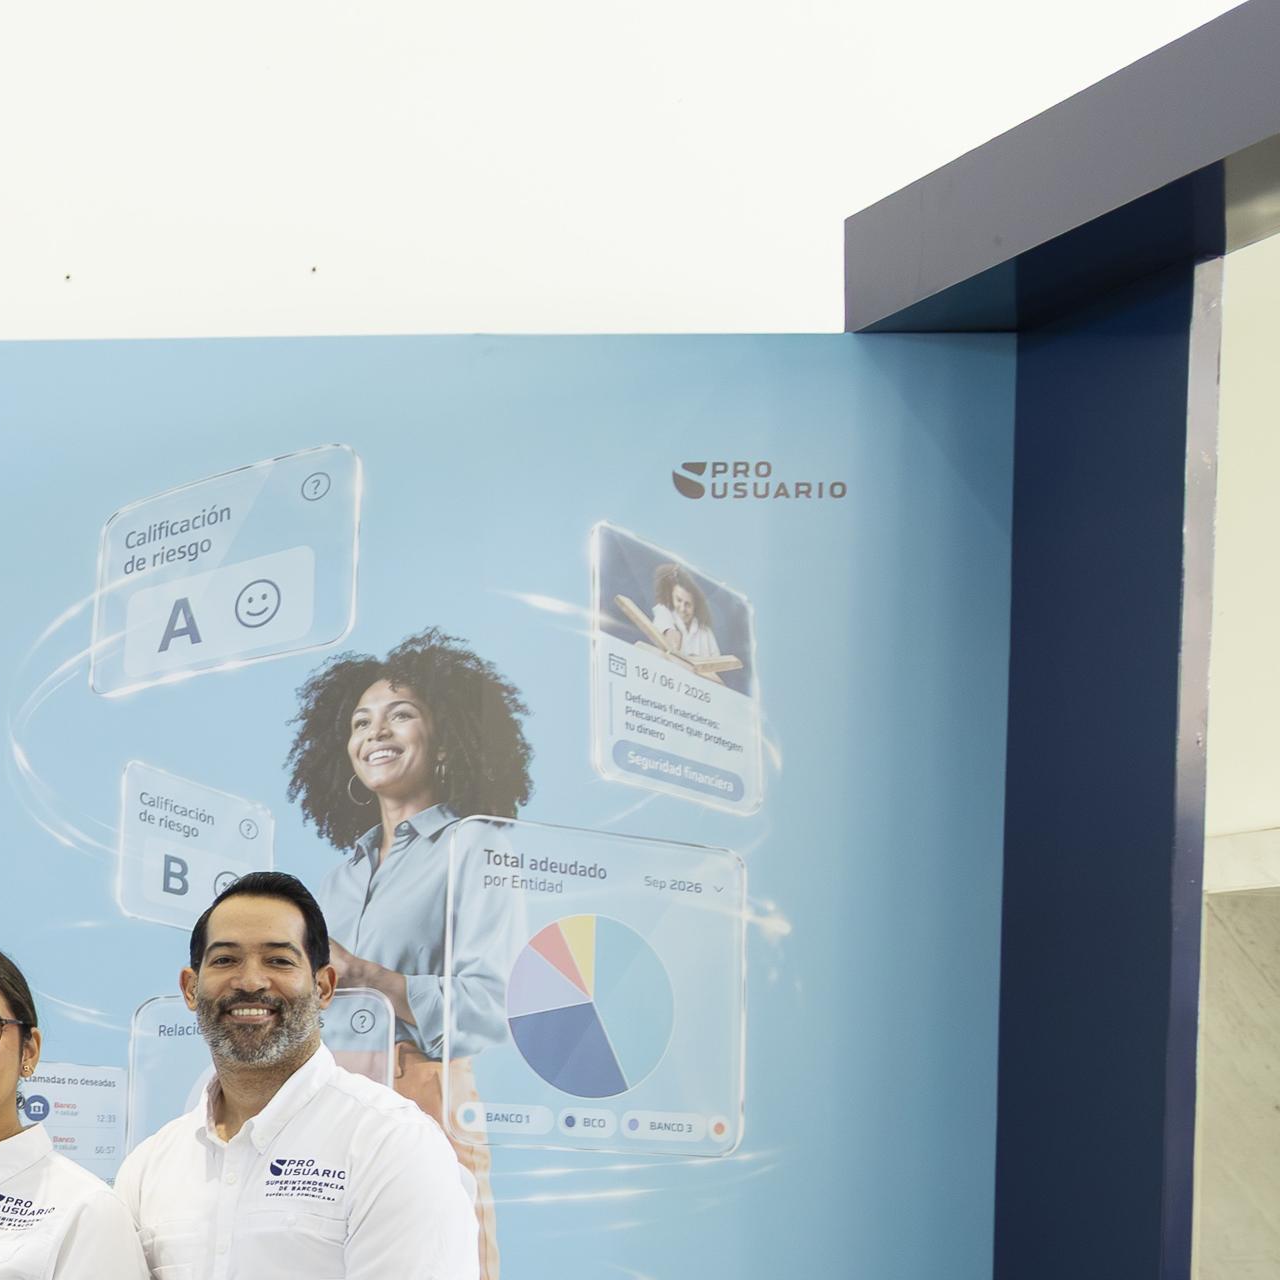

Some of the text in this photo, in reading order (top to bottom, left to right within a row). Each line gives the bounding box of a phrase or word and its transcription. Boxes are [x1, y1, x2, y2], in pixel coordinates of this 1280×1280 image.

[711, 461, 772, 478] PRO
[711, 481, 847, 499] USUARIO
[124, 504, 231, 550] Calificación
[123, 538, 212, 575] de riesgo
[157, 597, 202, 653] A
[625, 706, 684, 732] Precauciones
[636, 724, 666, 741] dinero
[627, 751, 734, 792] Seguridad financiera
[139, 791, 215, 825] Calificación
[139, 809, 200, 838] de riesgo
[162, 854, 189, 896] B
[483, 849, 608, 880] Total adeudado
[484, 873, 564, 894] por Entidad
[643, 876, 703, 894] Sep 2026
[486, 1112, 523, 1124] BANCO
[583, 1117, 606, 1129] BCO
[649, 1121, 684, 1133] BANCO
[287, 1159, 315, 1167] PRO
[4, 1196, 33, 1208] PRO
